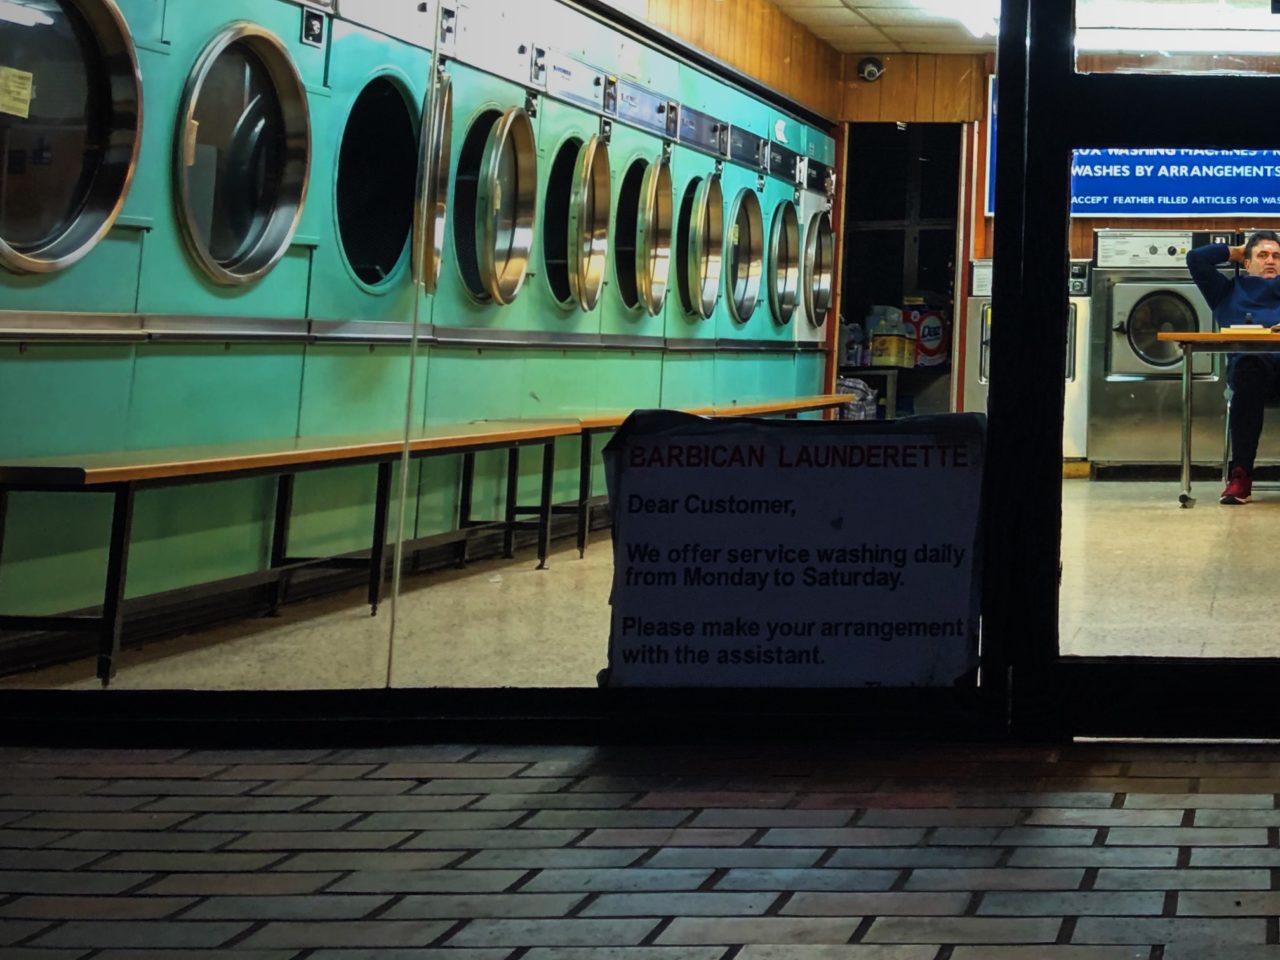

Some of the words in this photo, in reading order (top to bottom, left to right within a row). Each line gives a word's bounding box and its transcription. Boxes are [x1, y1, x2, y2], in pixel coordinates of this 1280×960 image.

[1071, 165, 1131, 177] WASHES
[1134, 165, 1154, 177] BY
[1070, 196, 1109, 204] ACCEPT
[1113, 196, 1155, 204] FEATHER
[1157, 196, 1189, 204] FILLED
[1191, 196, 1237, 204] ARTICLES
[1240, 196, 1259, 204] FOR
[629, 445, 764, 469] BARBICAN
[778, 444, 969, 468] LAUNDERETTE
[628, 494, 679, 515] Dear
[685, 494, 797, 518] Customer,
[626, 544, 660, 563] We
[667, 544, 722, 563] offer
[727, 545, 810, 564] service
[817, 543, 907, 567] washing
[914, 543, 966, 568] daily
[625, 566, 677, 586] from
[683, 566, 769, 591] Monday
[773, 568, 795, 587] to
[802, 566, 905, 591] Saturday.
[621, 617, 695, 637] Please
[702, 617, 760, 637] make
[766, 622, 816, 641] your
[821, 619, 964, 642] arrangement
[622, 646, 669, 664] with
[675, 646, 709, 664] the
[716, 646, 825, 665] assistant.
